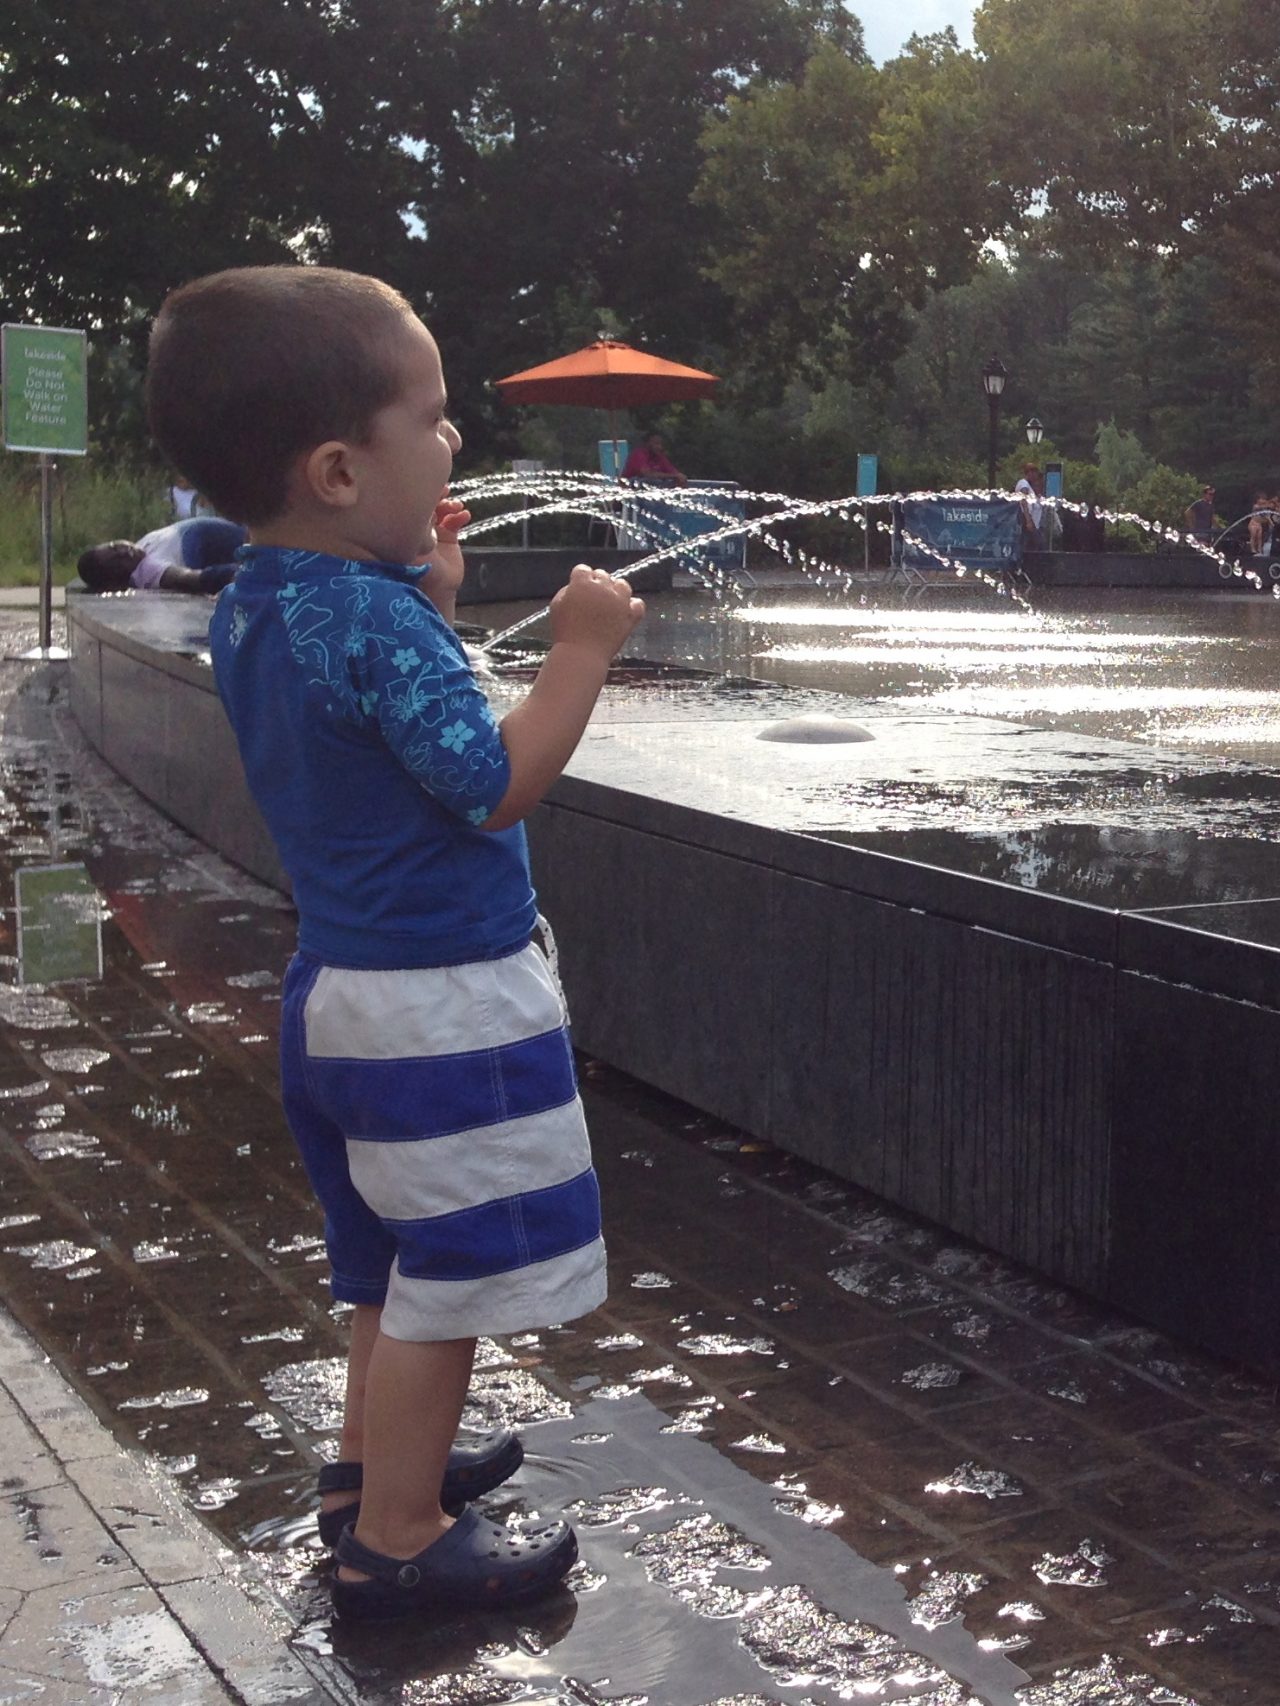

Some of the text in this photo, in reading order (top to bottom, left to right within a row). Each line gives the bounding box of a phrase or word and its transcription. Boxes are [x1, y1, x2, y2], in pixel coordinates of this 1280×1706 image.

[28, 367, 63, 380] Please
[26, 377, 65, 391] Do Not
[23, 390, 68, 403] Walk on
[30, 401, 62, 413] Water
[26, 411, 66, 425] Feature
[942, 507, 989, 523] lakeside
